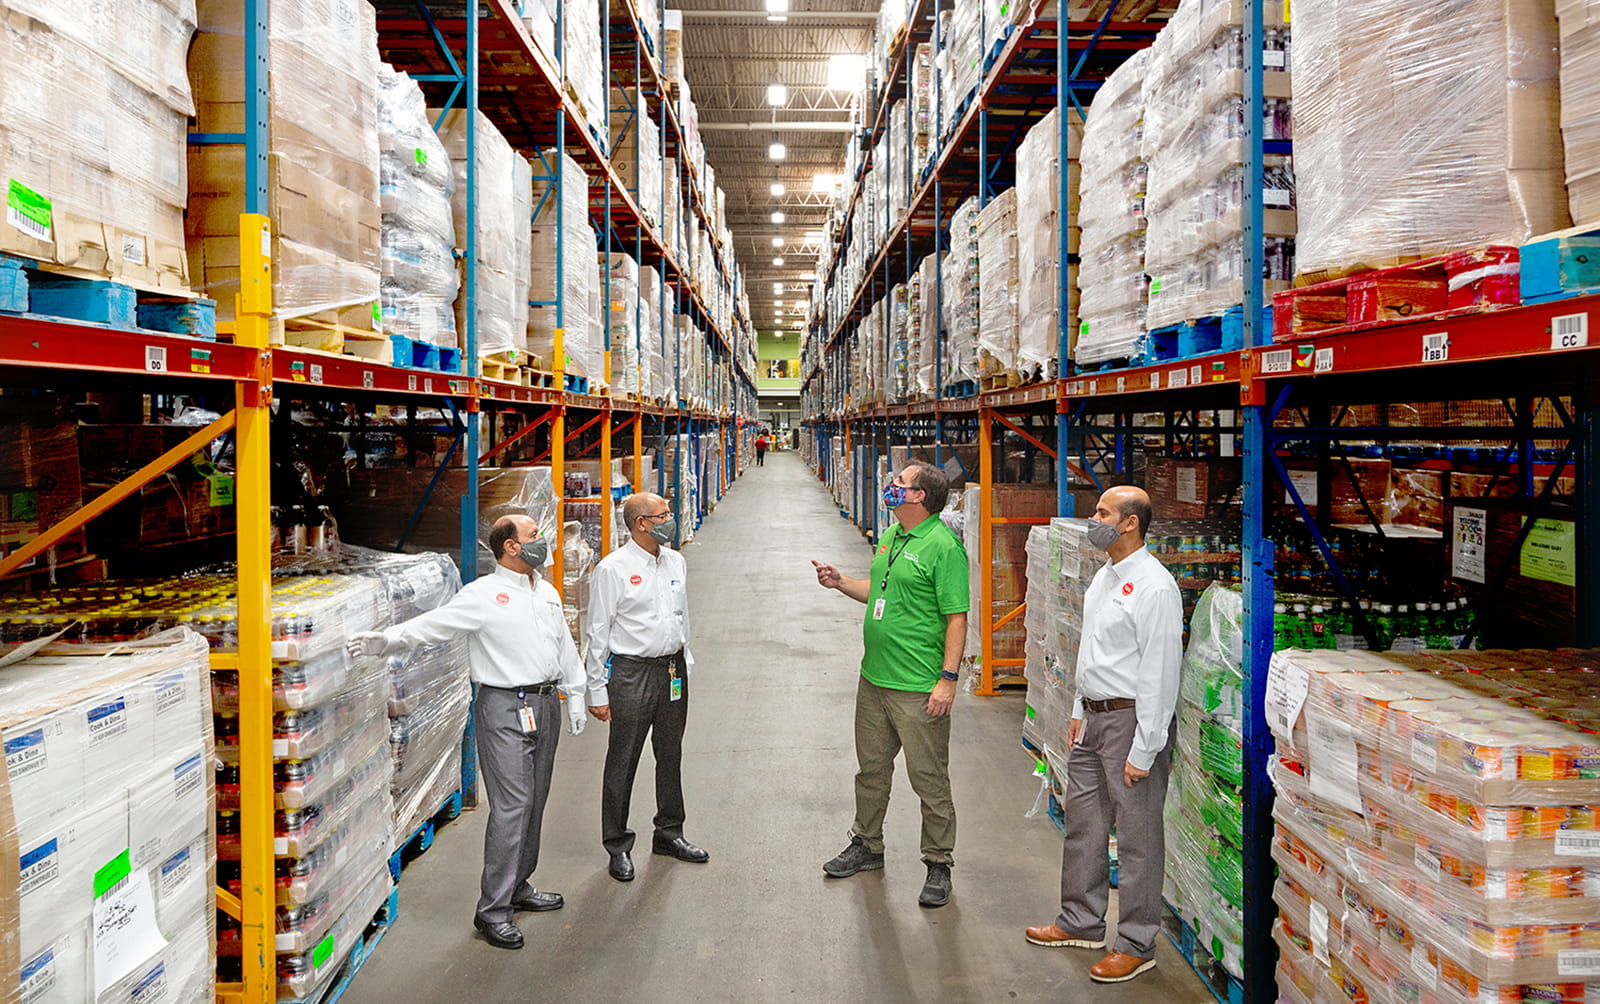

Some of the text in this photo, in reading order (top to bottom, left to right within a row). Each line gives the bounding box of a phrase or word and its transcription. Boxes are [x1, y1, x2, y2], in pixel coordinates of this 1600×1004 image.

[1562, 335, 1577, 347] CC
[1430, 350, 1441, 361] BB
[151, 361, 161, 370] DD
[90, 722, 104, 732] Cook
[109, 715, 121, 724] Dine
[18, 753, 24, 762] &
[24, 748, 39, 759] Dine
[37, 860, 52, 871] Dine
